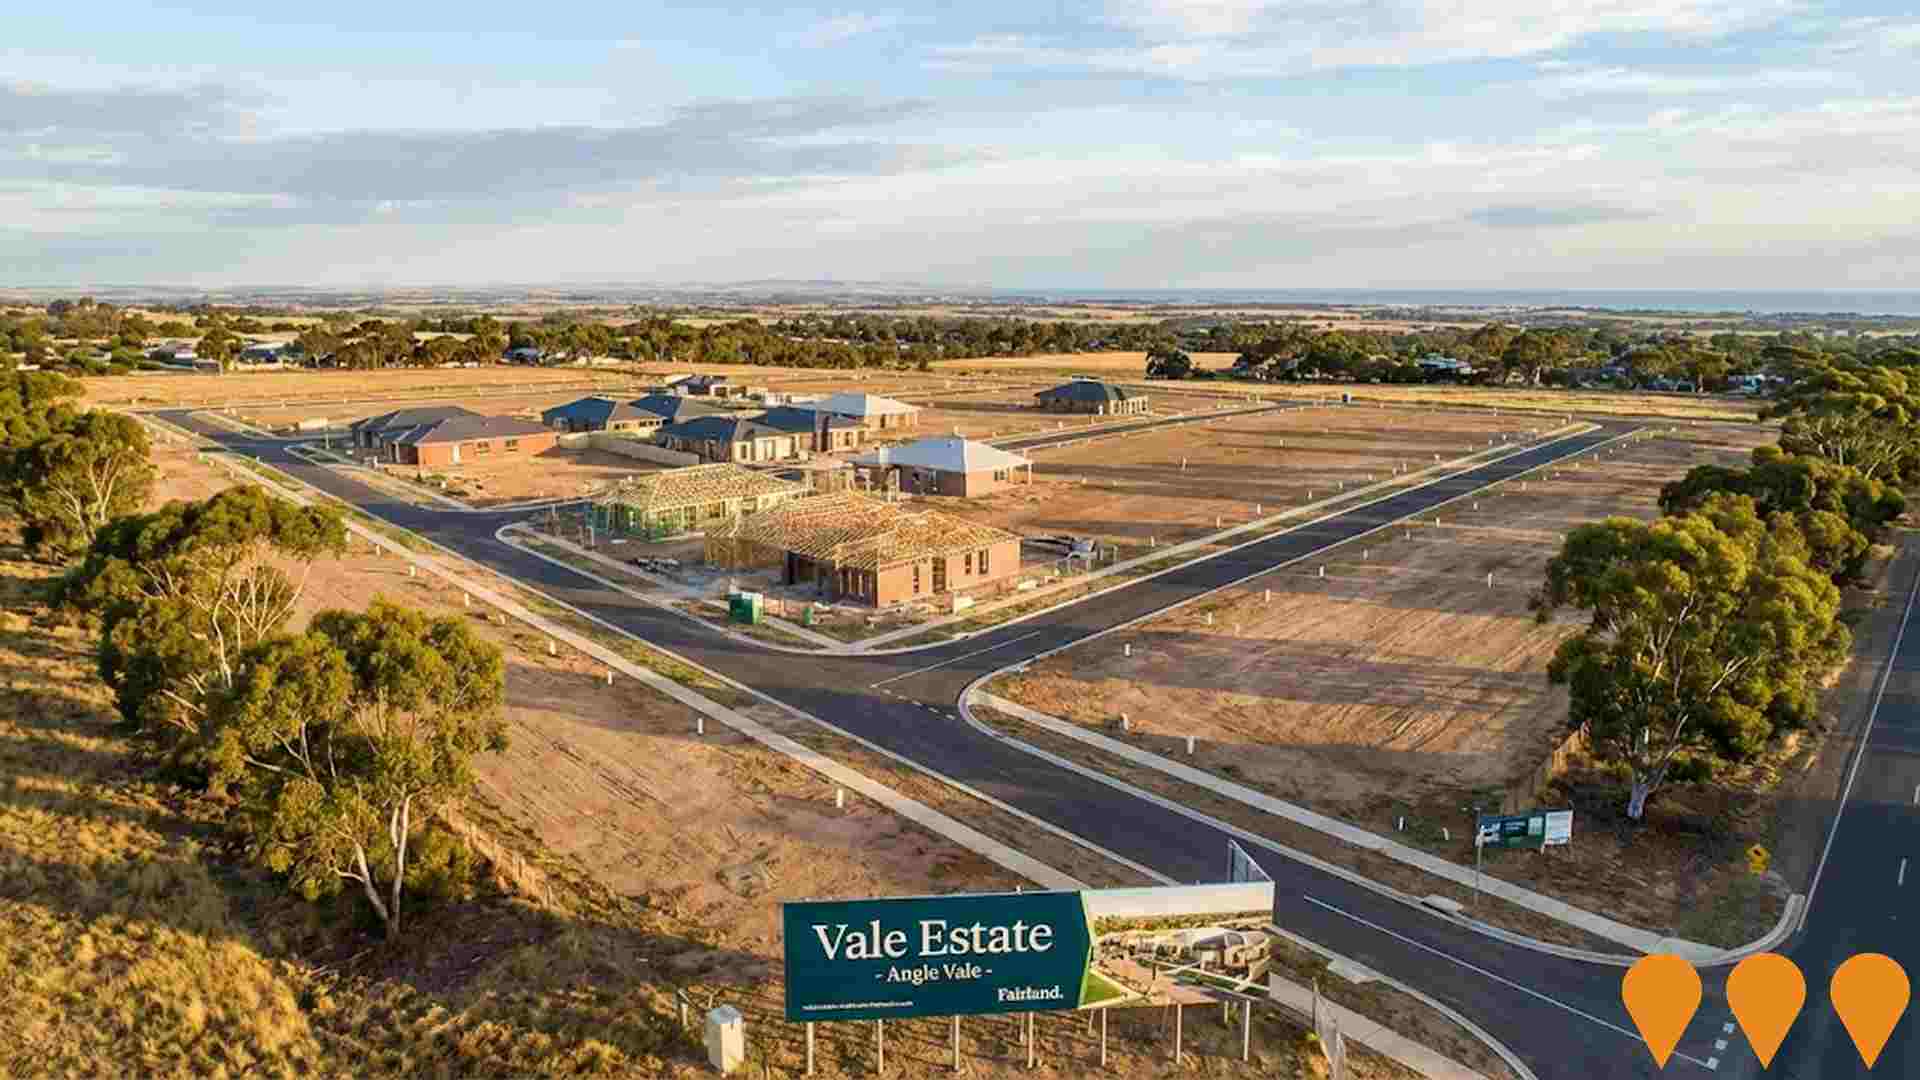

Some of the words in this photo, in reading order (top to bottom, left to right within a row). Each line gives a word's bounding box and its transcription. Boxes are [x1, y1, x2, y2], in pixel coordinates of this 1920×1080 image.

[813, 919, 907, 960] Vale
[918, 919, 1053, 957] Estate
[887, 964, 939, 986] Angle
[943, 963, 983, 980] Vale
[997, 986, 1064, 1002] Fairland.
